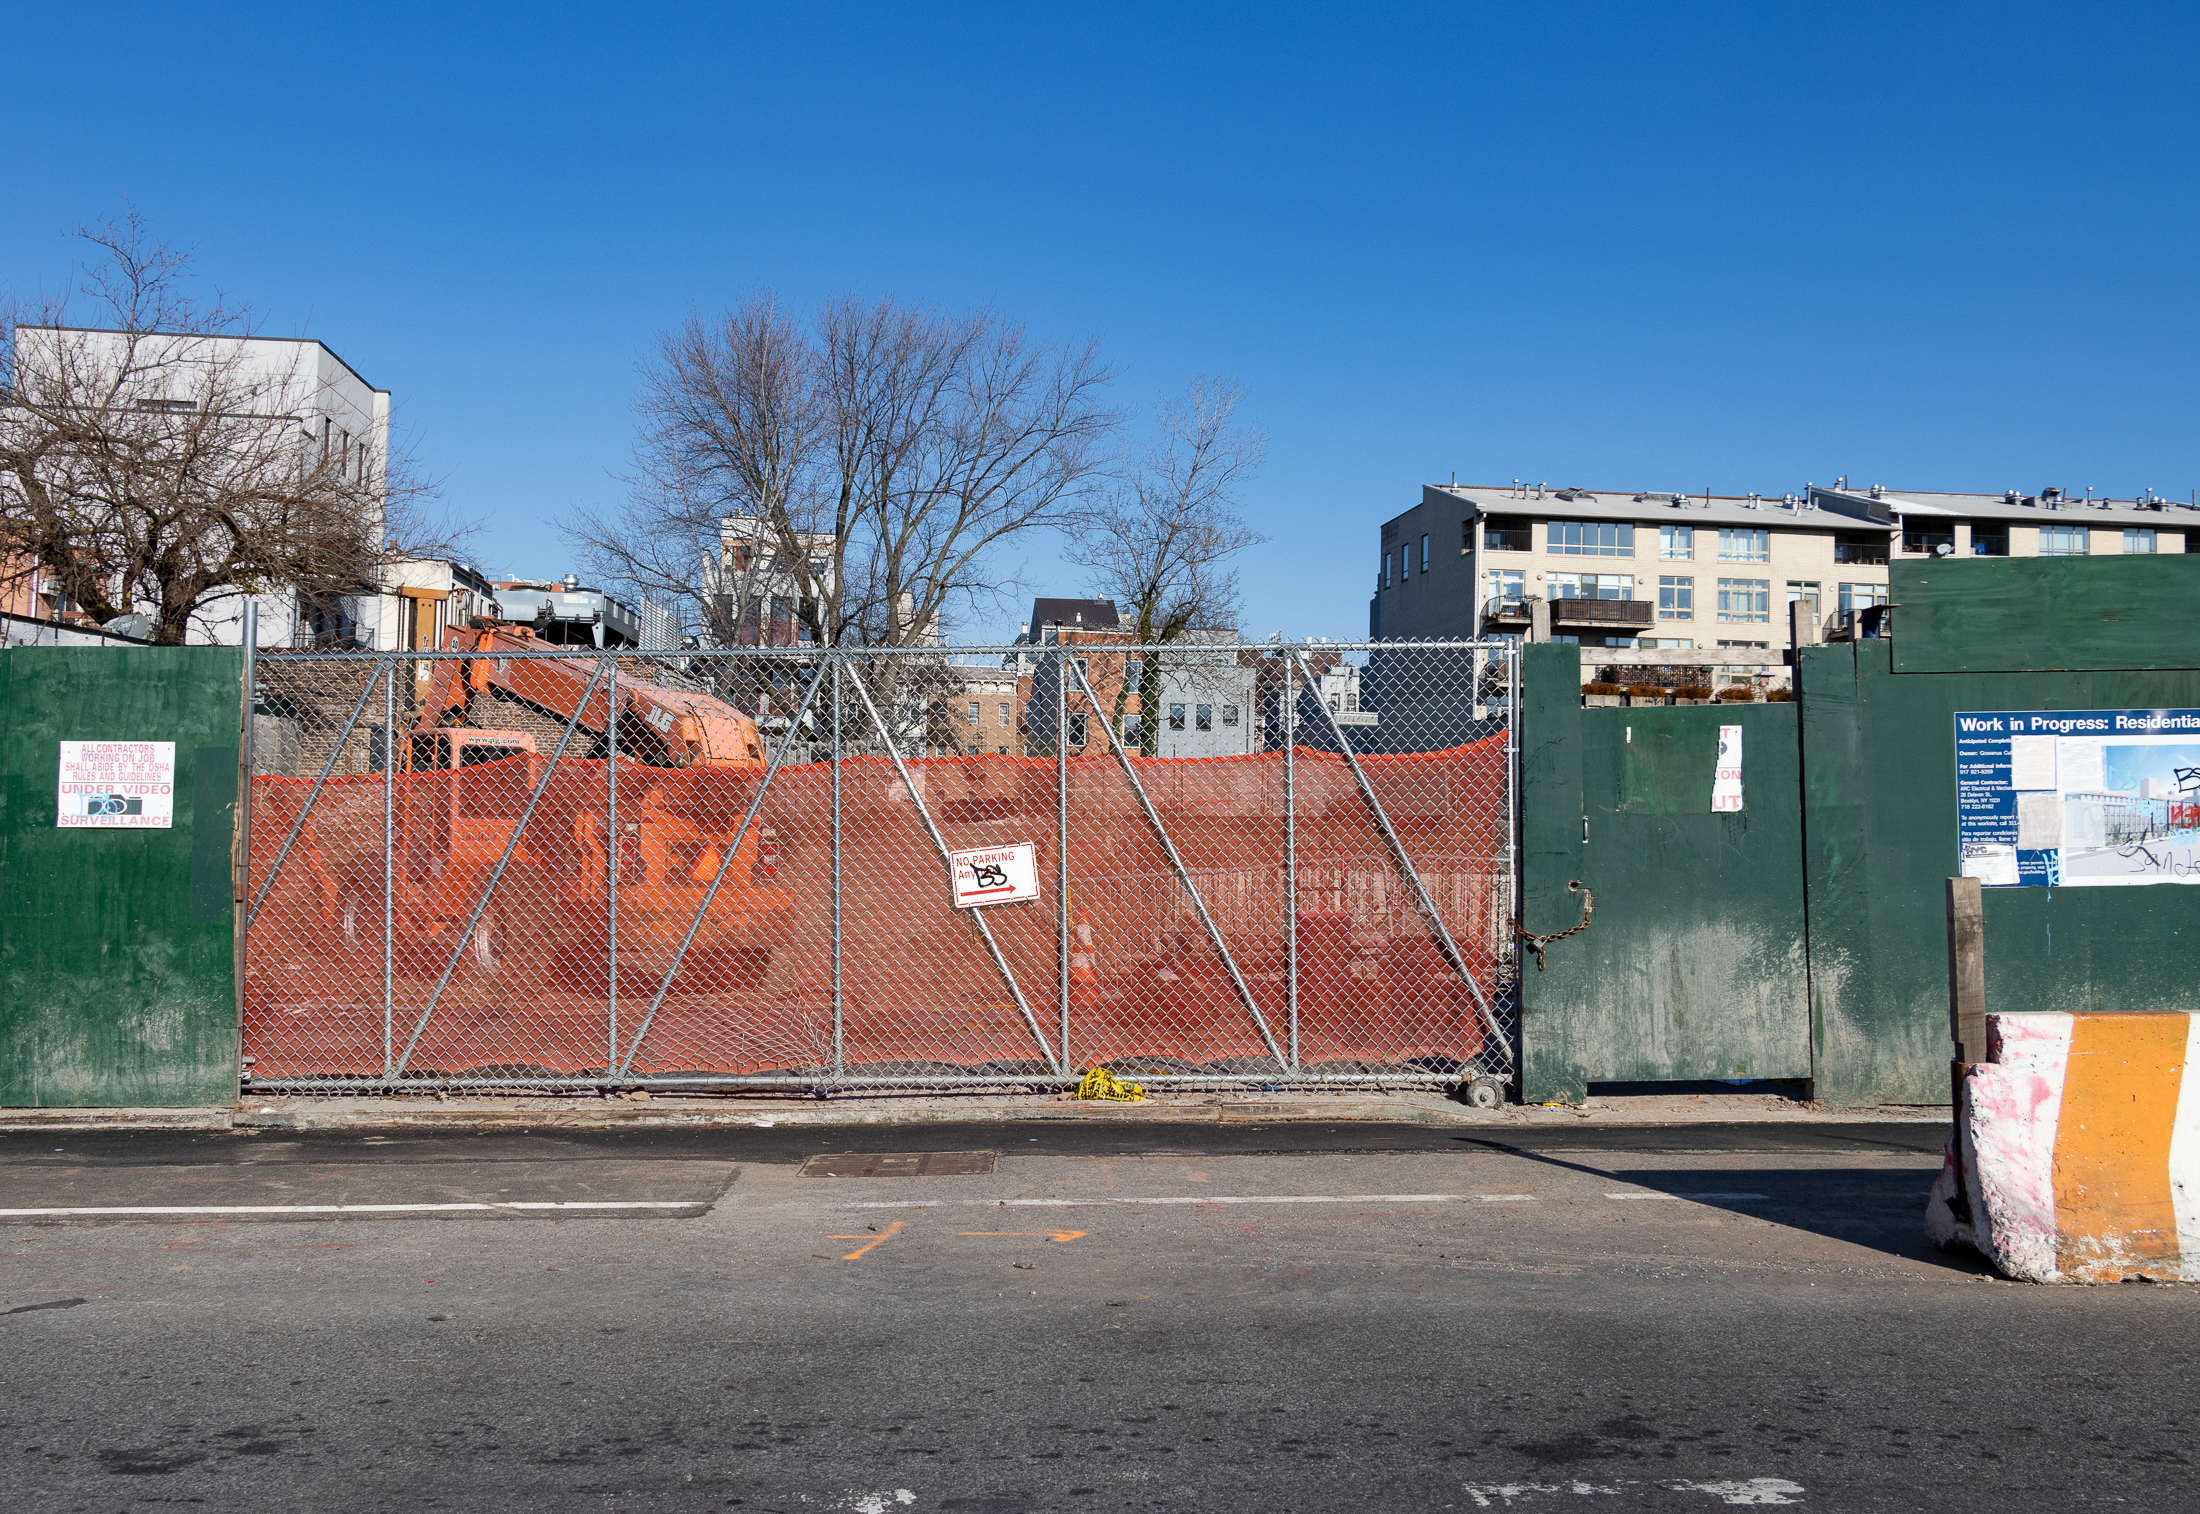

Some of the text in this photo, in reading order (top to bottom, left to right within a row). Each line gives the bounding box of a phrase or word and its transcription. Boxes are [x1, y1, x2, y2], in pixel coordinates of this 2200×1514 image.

[1960, 717, 2004, 732] Work
[2010, 717, 2024, 730] in
[2031, 716, 2108, 733] Progress:
[82, 744, 154, 754] ALL CONTRACTORS
[82, 754, 155, 762] WORKING ON JOB
[66, 762, 169, 772] SHALL ABIDE BY THE OSHA
[73, 772, 162, 781] RULES AND GUIDELINES
[62, 785, 171, 794] UNDER VIDEO
[60, 816, 170, 826] SURVEILLANCE
[956, 851, 1014, 867] NO PARKING
